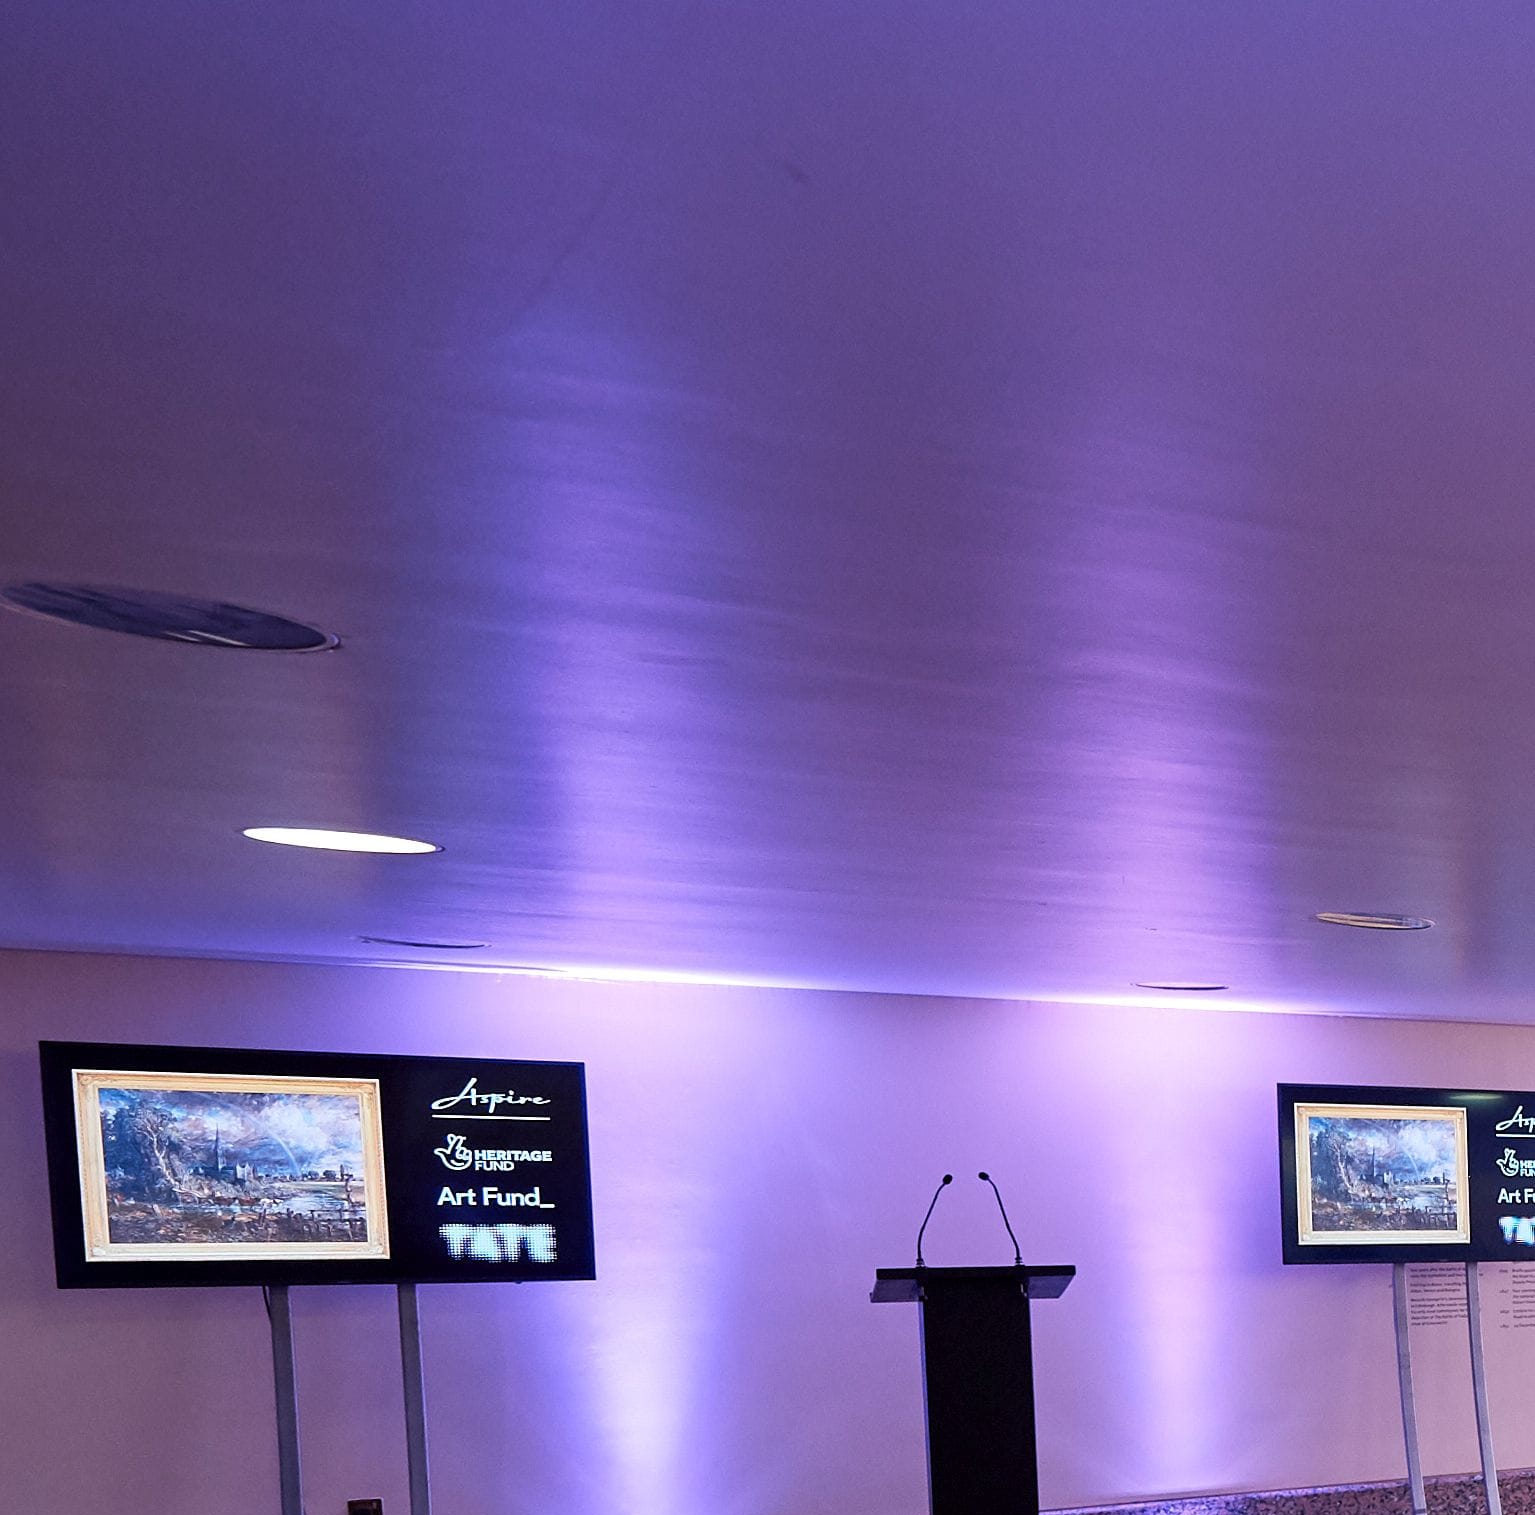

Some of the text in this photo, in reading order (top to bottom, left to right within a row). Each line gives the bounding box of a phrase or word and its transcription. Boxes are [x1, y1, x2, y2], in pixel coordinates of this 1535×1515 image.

[431, 1077, 551, 1114] Aspire
[474, 1149, 553, 1162] HERITAGE
[474, 1161, 515, 1171] FUND
[437, 1186, 477, 1206] Art
[1497, 1187, 1521, 1204] Art
[438, 1223, 557, 1263] TATE
